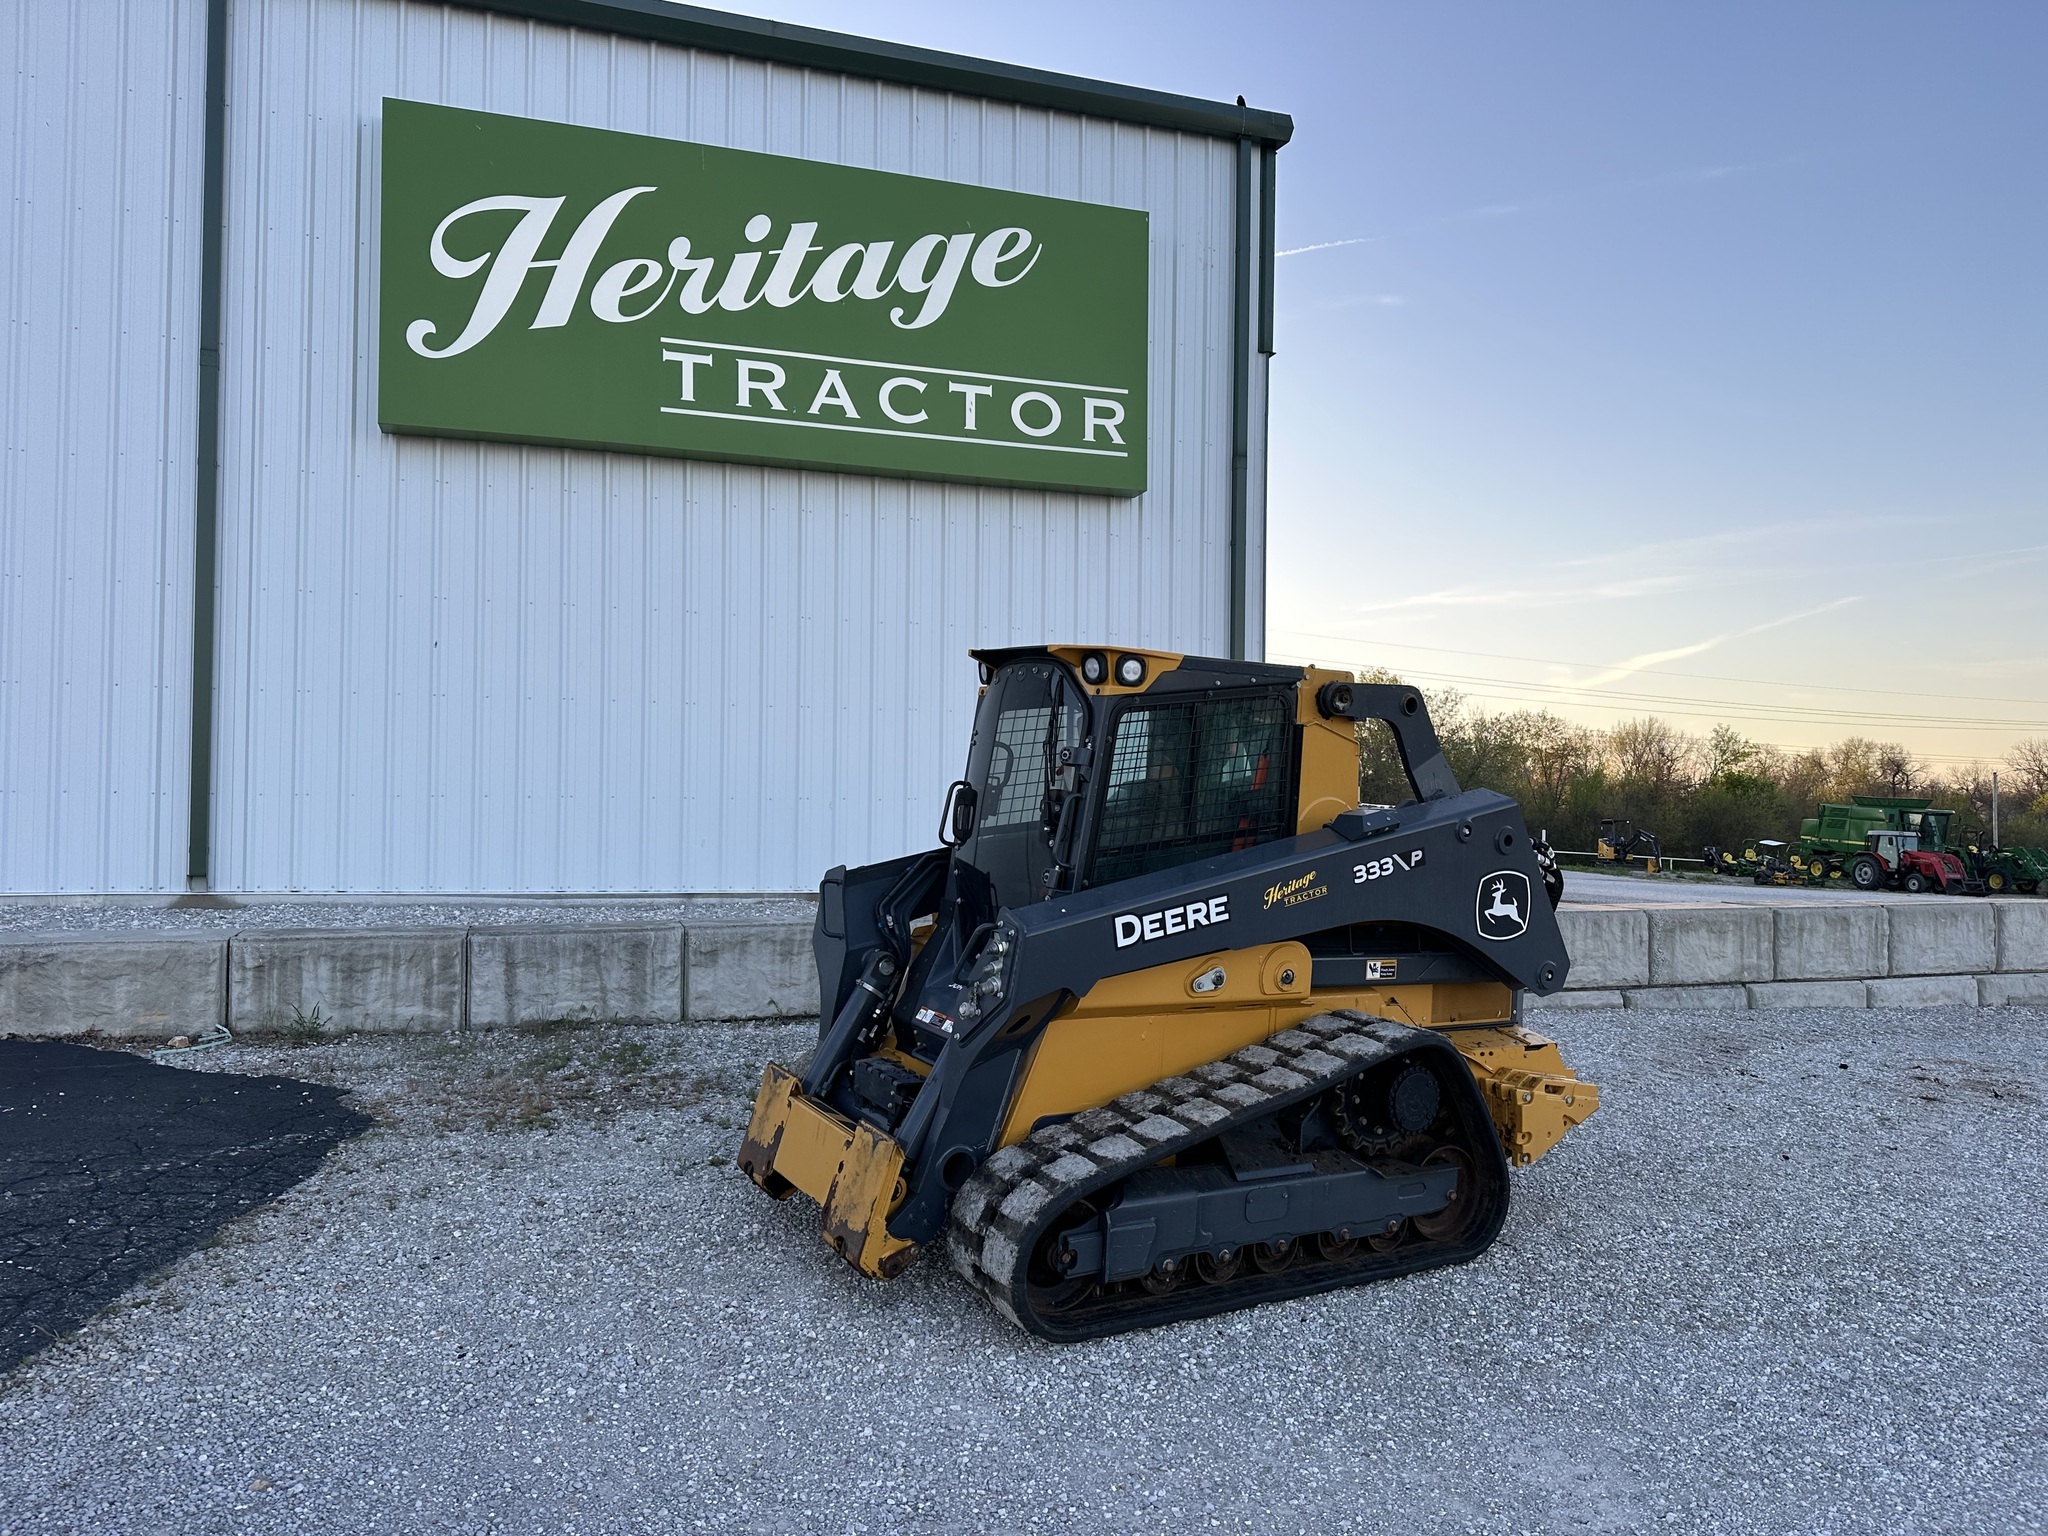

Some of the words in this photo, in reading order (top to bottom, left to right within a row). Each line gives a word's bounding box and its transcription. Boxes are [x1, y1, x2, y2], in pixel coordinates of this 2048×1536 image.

[406, 186, 1042, 359] Heritage
[661, 348, 1127, 445] TRACTOR
[1263, 870, 1317, 910] Heritage
[1283, 887, 1328, 905] TRACTOR
[1114, 895, 1230, 948] DEERE
